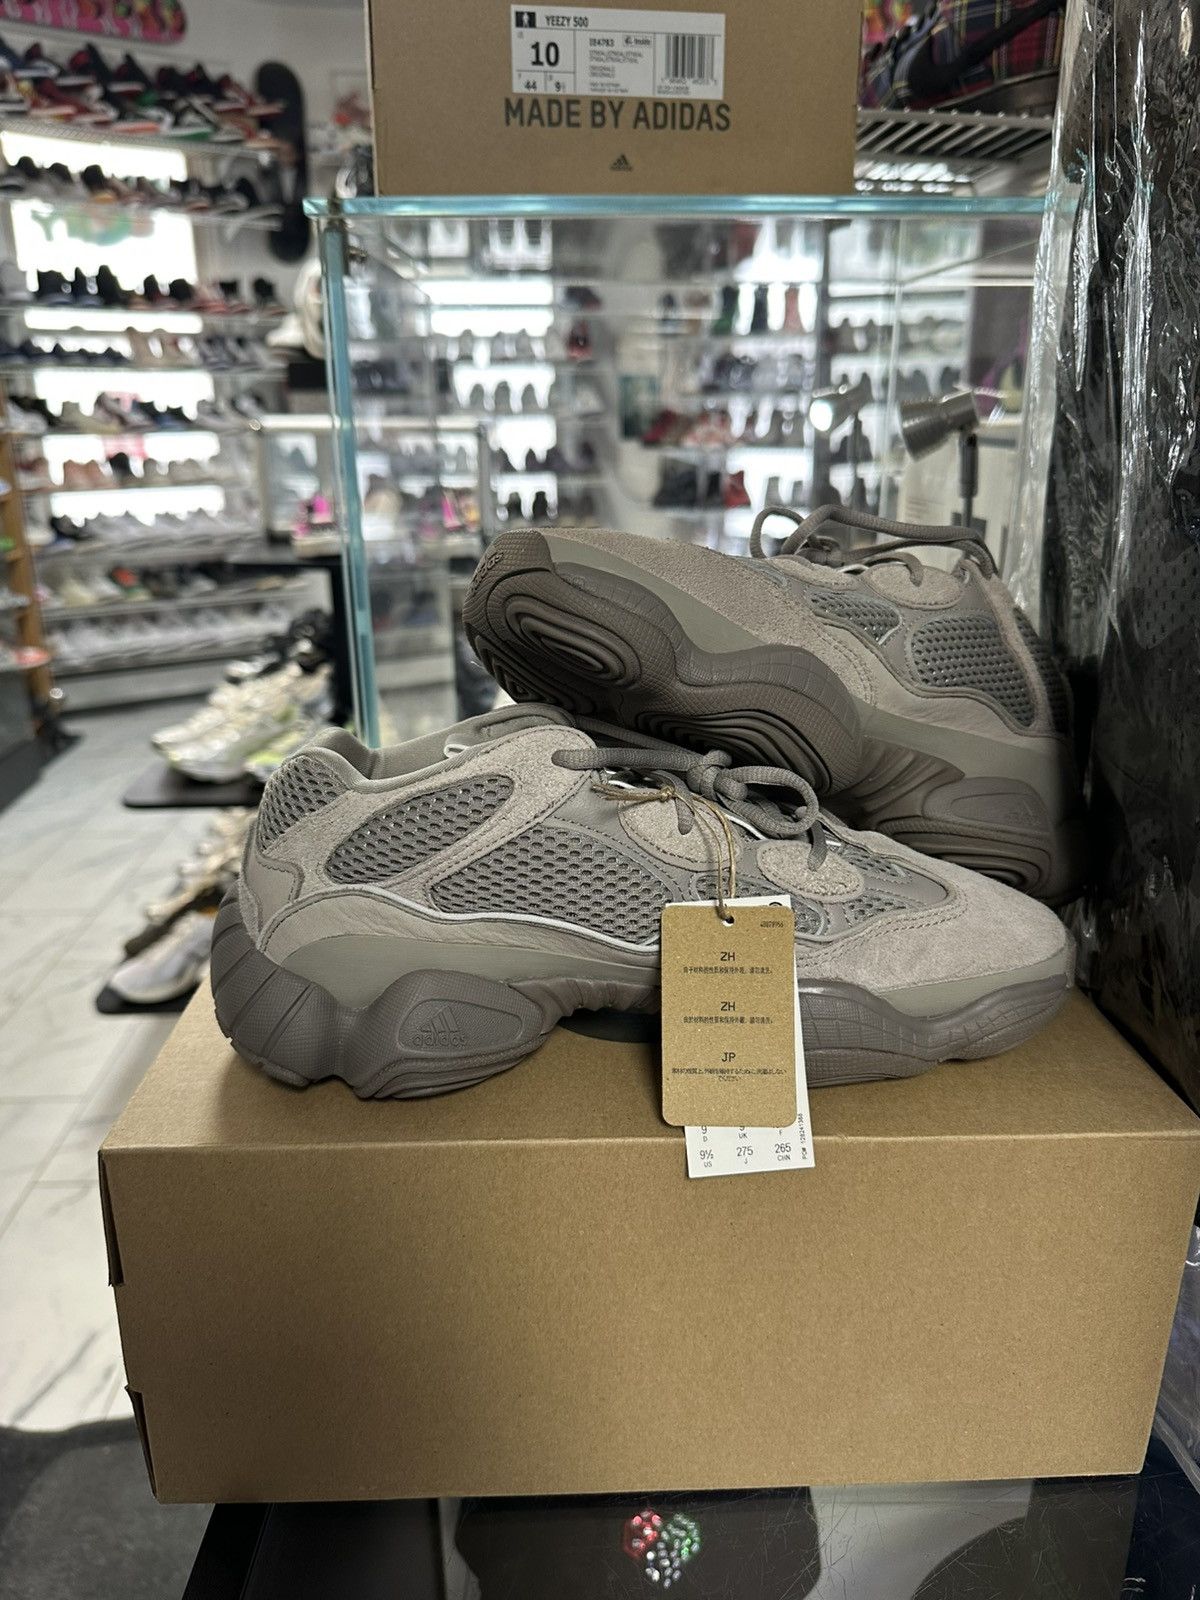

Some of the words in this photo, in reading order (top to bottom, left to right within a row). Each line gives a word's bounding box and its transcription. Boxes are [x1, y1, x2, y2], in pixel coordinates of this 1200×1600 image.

[545, 15, 571, 27] YEEZY
[573, 16, 589, 28] 500
[531, 41, 560, 66] 10
[524, 80, 537, 91] 44
[505, 98, 581, 127] MADE
[591, 101, 624, 129] BY
[633, 102, 731, 131] ADIDAS
[720, 952, 736, 962] ZH
[720, 1002, 736, 1011] ZH
[412, 1033, 466, 1048] adidas
[721, 1052, 736, 1062] JP
[736, 1146, 754, 1157] 275
[774, 1143, 792, 1154] 265
[777, 1154, 791, 1162] CHN
